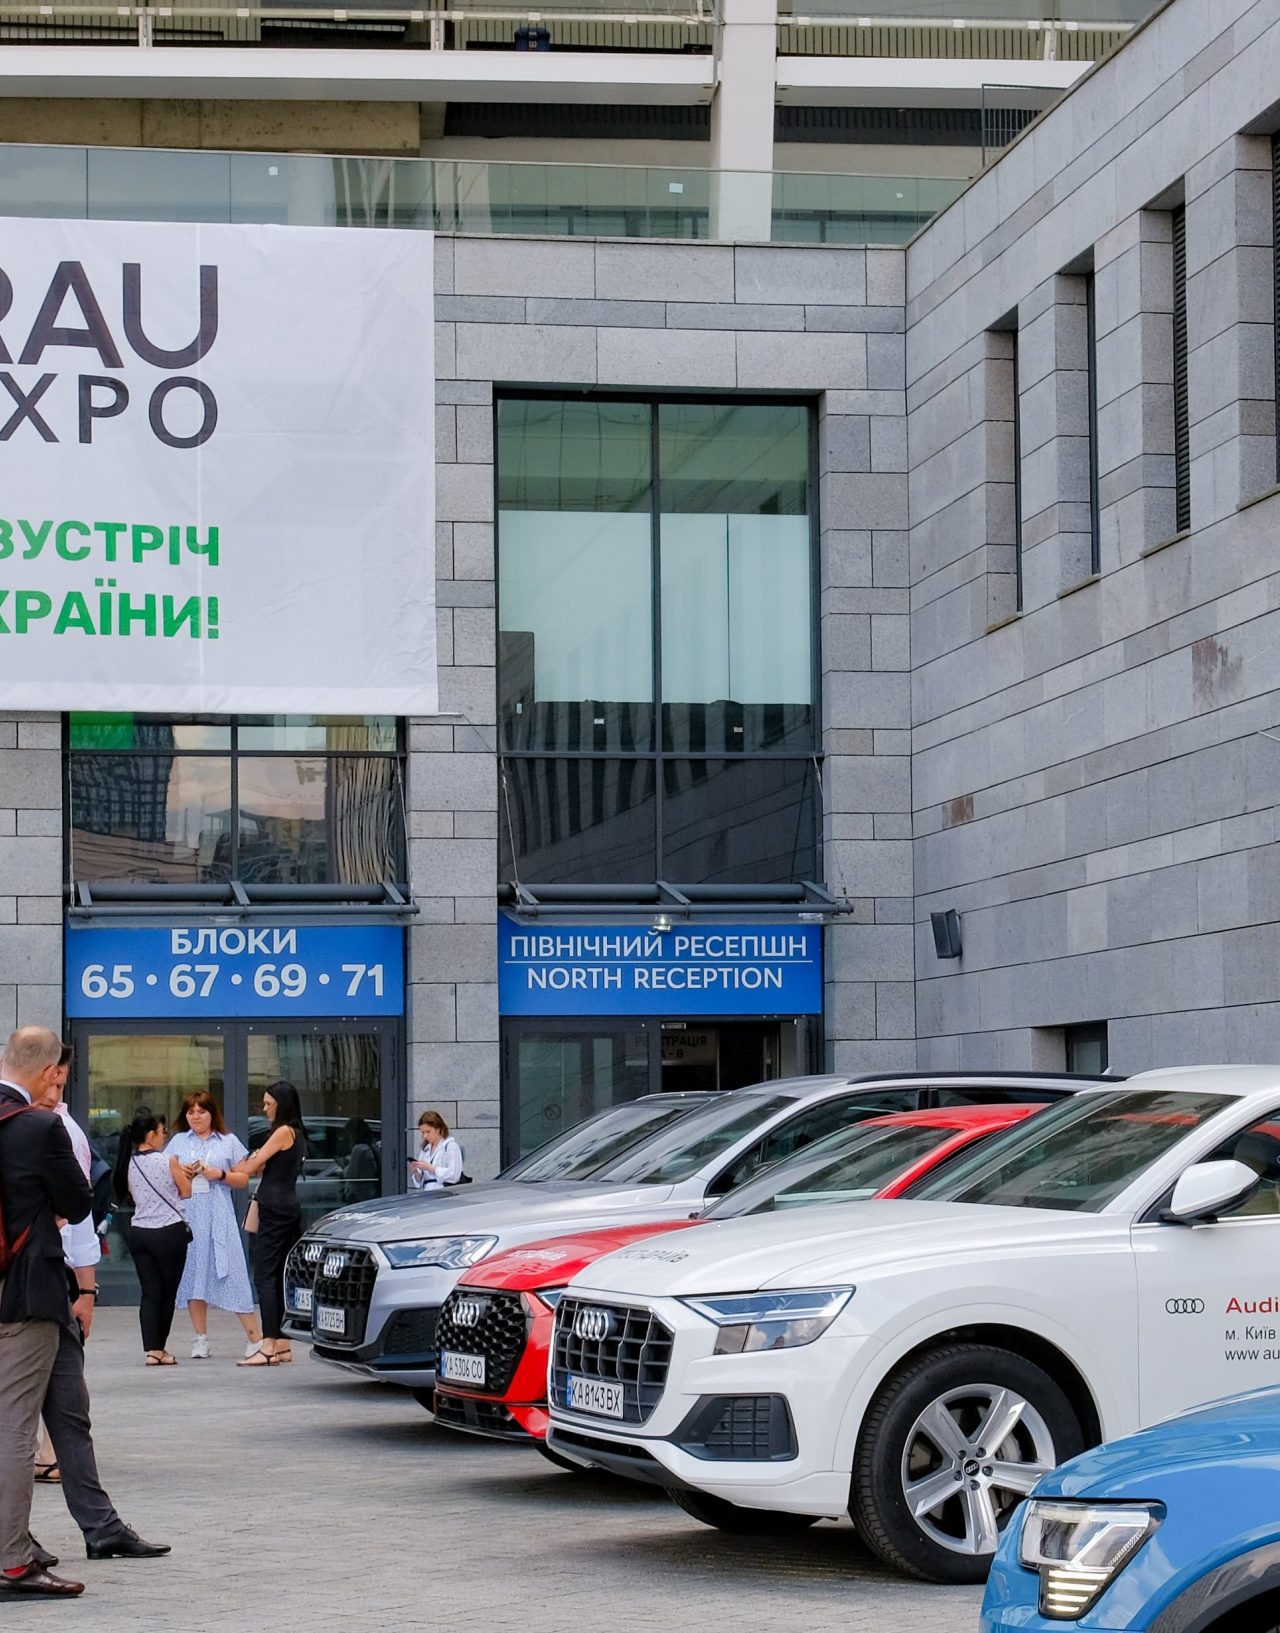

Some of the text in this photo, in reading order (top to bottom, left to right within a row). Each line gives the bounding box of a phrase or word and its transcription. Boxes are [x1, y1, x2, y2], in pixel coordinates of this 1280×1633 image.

[171, 928, 297, 955] БЛОКИ
[510, 931, 807, 958] ПІВНІЧНИЙ РЕСЕПШН
[81, 963, 384, 998] 65 67 69 71
[527, 967, 783, 989] NORTH RECEPTION
[1225, 1296, 1279, 1314] Audi
[1245, 1326, 1276, 1340] Київ
